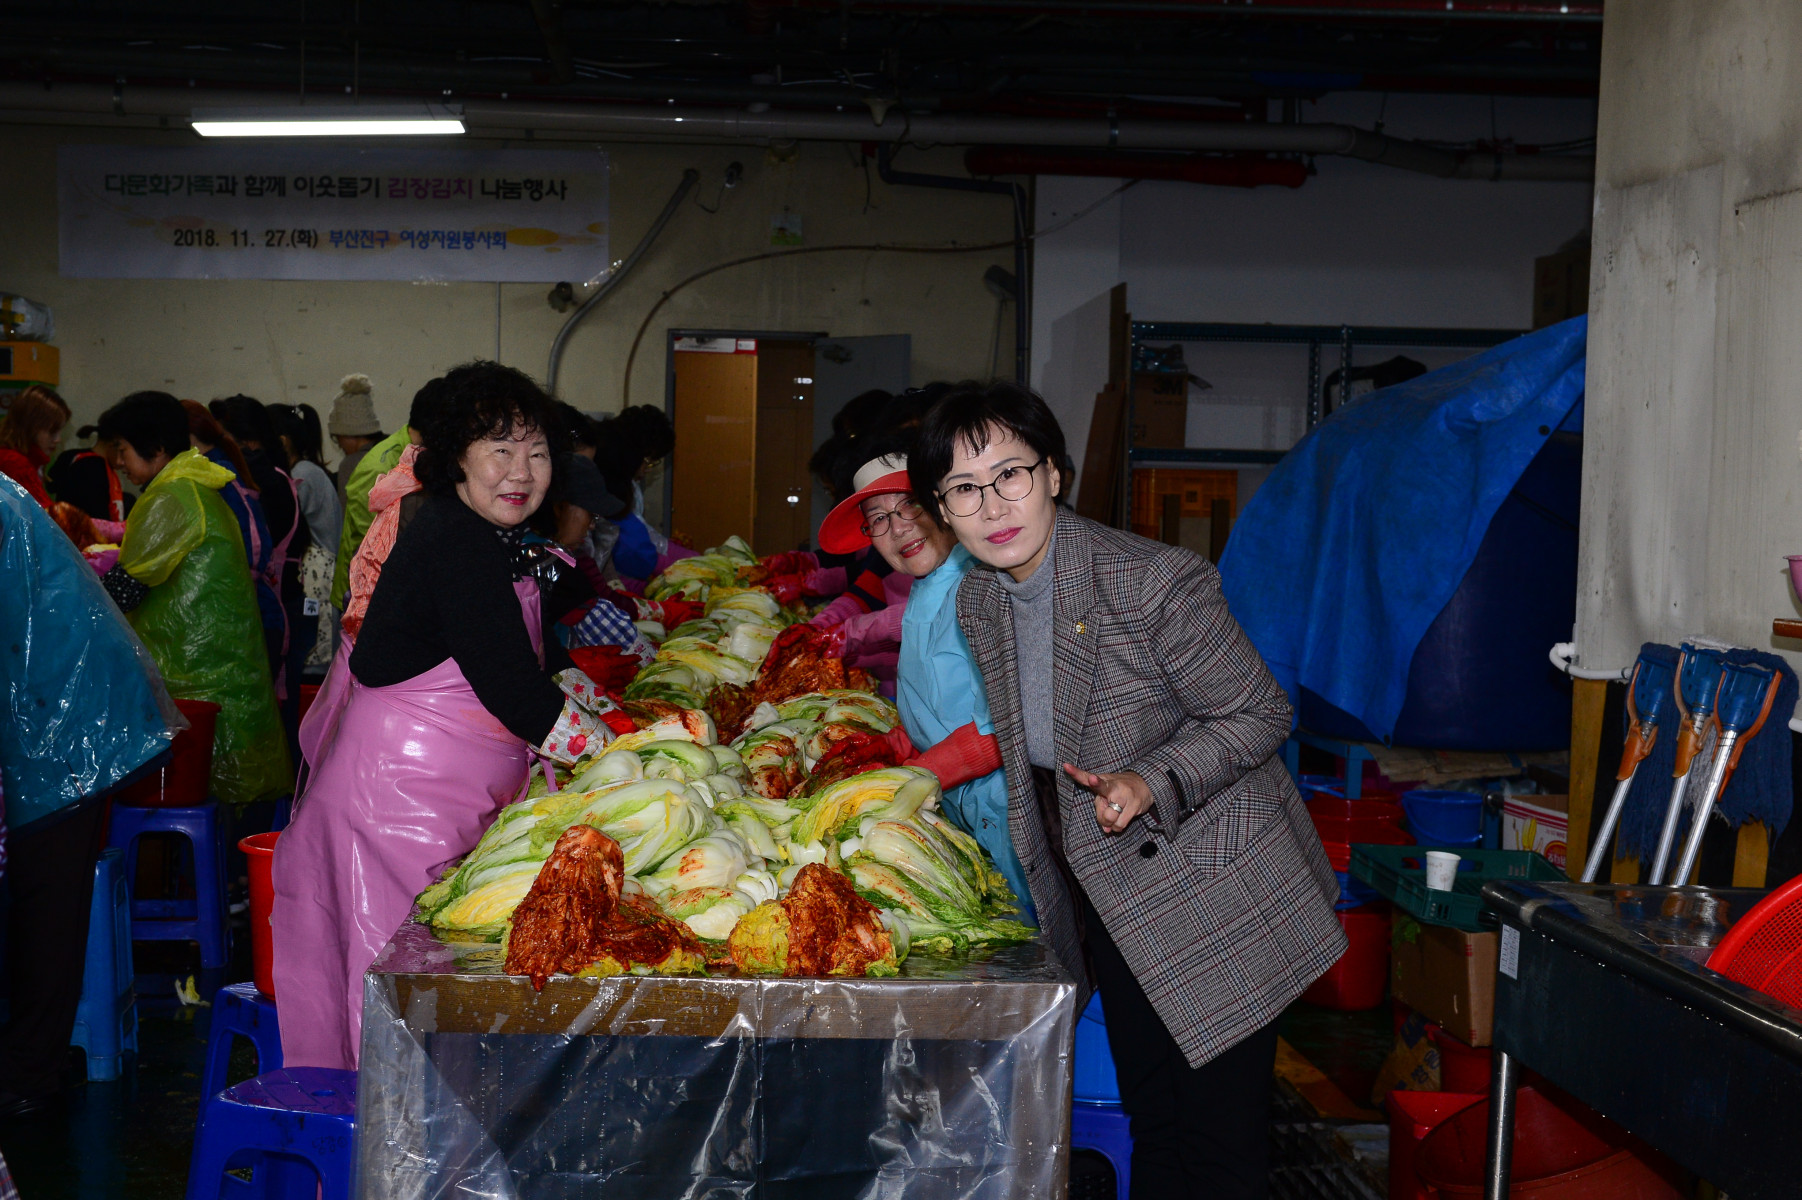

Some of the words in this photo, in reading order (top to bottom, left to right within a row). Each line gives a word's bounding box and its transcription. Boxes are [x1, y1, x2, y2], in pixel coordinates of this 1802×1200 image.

[105, 174, 238, 197] 다문화가족과
[244, 175, 286, 198] 함께
[294, 175, 380, 198] 이웃돕기
[388, 177, 472, 199] 김장김치
[481, 178, 567, 201] 나눔행사
[174, 229, 219, 247] 2018.
[231, 230, 254, 247] 11.
[265, 229, 318, 248] 27.(화)
[329, 230, 389, 249] 부산진구
[400, 230, 507, 250] 여성자원봉사회
[1154, 377, 1183, 395] 3M
